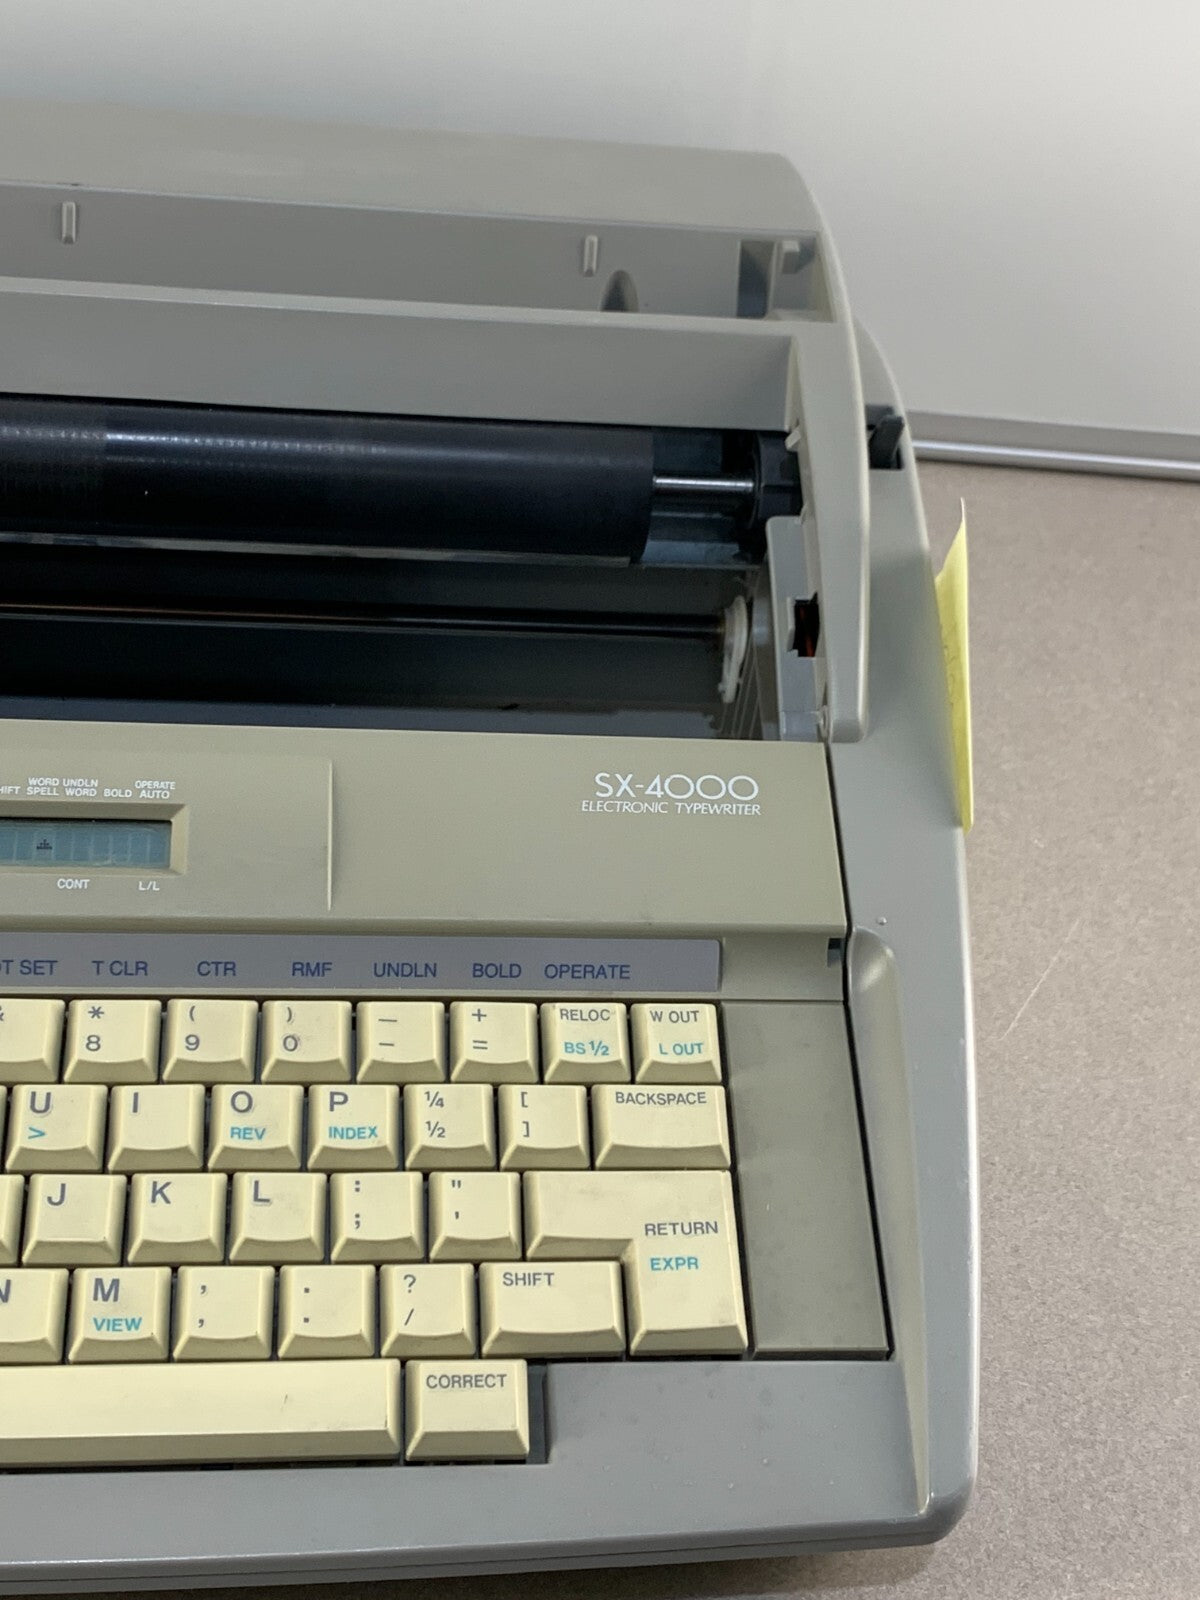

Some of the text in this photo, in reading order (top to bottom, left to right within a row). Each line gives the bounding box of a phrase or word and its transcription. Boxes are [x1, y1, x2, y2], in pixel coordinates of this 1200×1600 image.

[28, 777, 99, 787] WORD UNDLN
[134, 780, 176, 790] OPERATE
[594, 772, 759, 801] SX-4000
[26, 786, 98, 797] SPELL WORD
[103, 788, 133, 798] BOLD
[139, 789, 170, 799] AUTO
[581, 800, 762, 816] ELECTRONIC TYPEWRITER
[57, 878, 91, 890] CONT
[138, 880, 160, 892] L/L
[19, 959, 59, 976] SET
[91, 960, 149, 977] T CLR
[196, 960, 237, 977] CTR
[291, 961, 333, 978] RMF
[373, 962, 438, 978] UNDLN
[472, 962, 522, 979] BOLD
[543, 963, 631, 980] OPERATE
[471, 1008, 488, 1023] +
[559, 1008, 611, 1022] RELOC
[649, 1009, 700, 1024] W OUT
[85, 1034, 102, 1052] 8
[184, 1033, 201, 1052] 9
[472, 1039, 489, 1050] =
[564, 1041, 587, 1055] BS
[658, 1042, 704, 1056] L OUT
[29, 1090, 52, 1114] U
[132, 1091, 139, 1114] I
[230, 1090, 254, 1114] O
[329, 1090, 349, 1112] P
[615, 1091, 707, 1106] BACKSPACE
[230, 1126, 267, 1141] REV
[328, 1125, 379, 1141] INDEX
[46, 1182, 67, 1207] J
[150, 1180, 172, 1205] K
[253, 1179, 271, 1204] L
[644, 1220, 719, 1237] RETURN
[649, 1256, 699, 1272] EXPR
[403, 1273, 417, 1294] ?
[502, 1271, 555, 1287] SHIFT
[92, 1277, 121, 1303] M
[92, 1316, 143, 1333] VIEW
[404, 1308, 415, 1326] /
[425, 1373, 508, 1390] CORRECT
